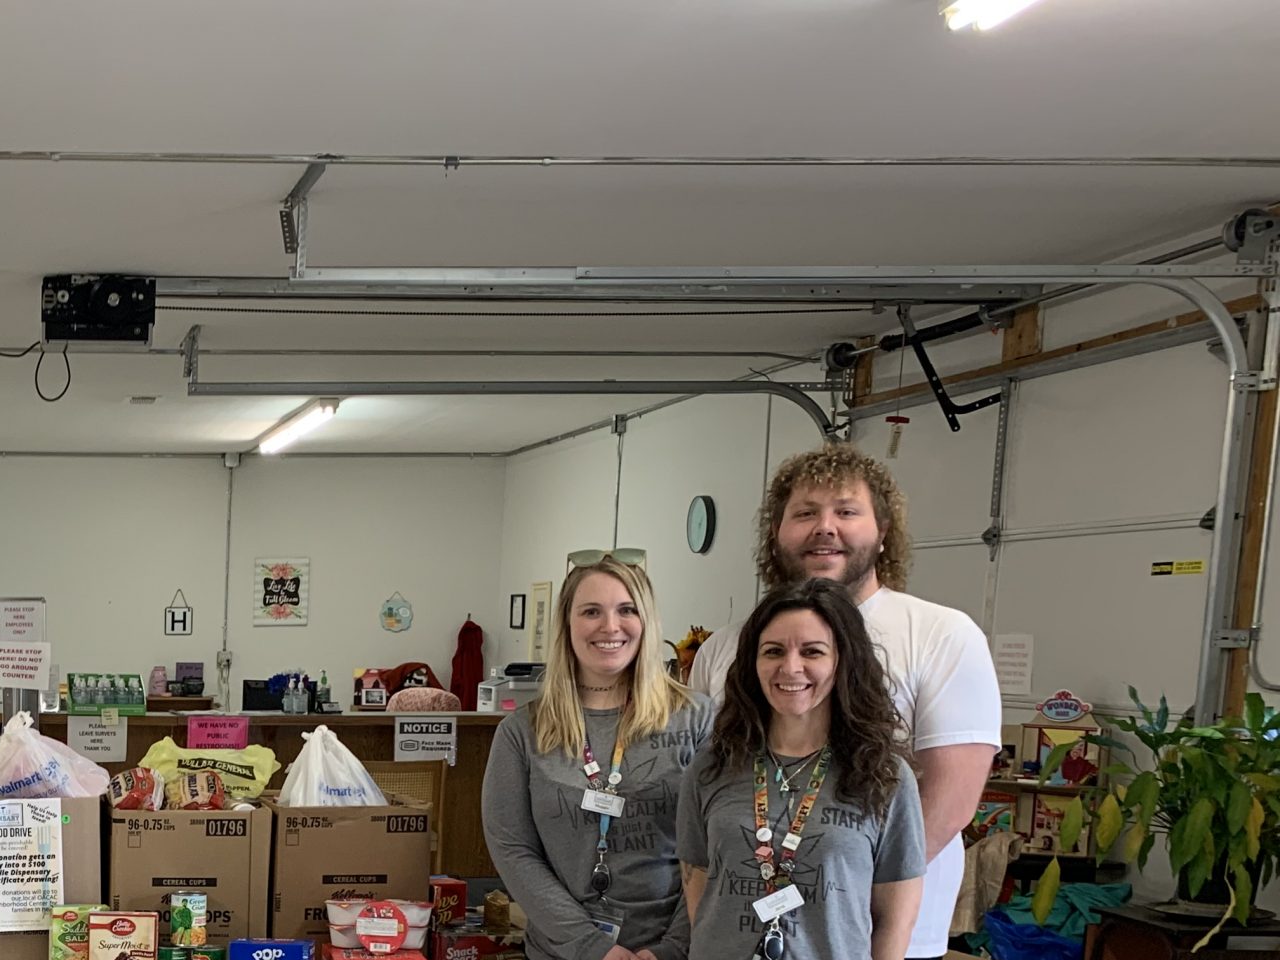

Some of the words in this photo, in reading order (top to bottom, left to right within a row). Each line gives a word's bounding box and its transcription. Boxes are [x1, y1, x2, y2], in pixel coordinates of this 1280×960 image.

[171, 611, 186, 631] H
[1047, 702, 1078, 712] WONDER
[404, 724, 448, 732] NOTICE
[650, 730, 690, 750] STAFF
[181, 759, 214, 768] DOLLAR
[216, 762, 252, 776] GENERAL
[27, 803, 38, 811] Help
[46, 810, 57, 818] Help
[31, 810, 45, 818] Those
[625, 801, 667, 819] CALM
[128, 819, 162, 830] 96-0.75
[286, 817, 320, 828] 96-0.75
[390, 817, 424, 831] 01796
[820, 808, 863, 831] STAFF
[10, 827, 32, 837] DRIVE
[209, 820, 244, 835] 01796
[11, 869, 51, 877] Dispensary
[730, 879, 763, 896] KEEP
[446, 946, 478, 960] Snack
